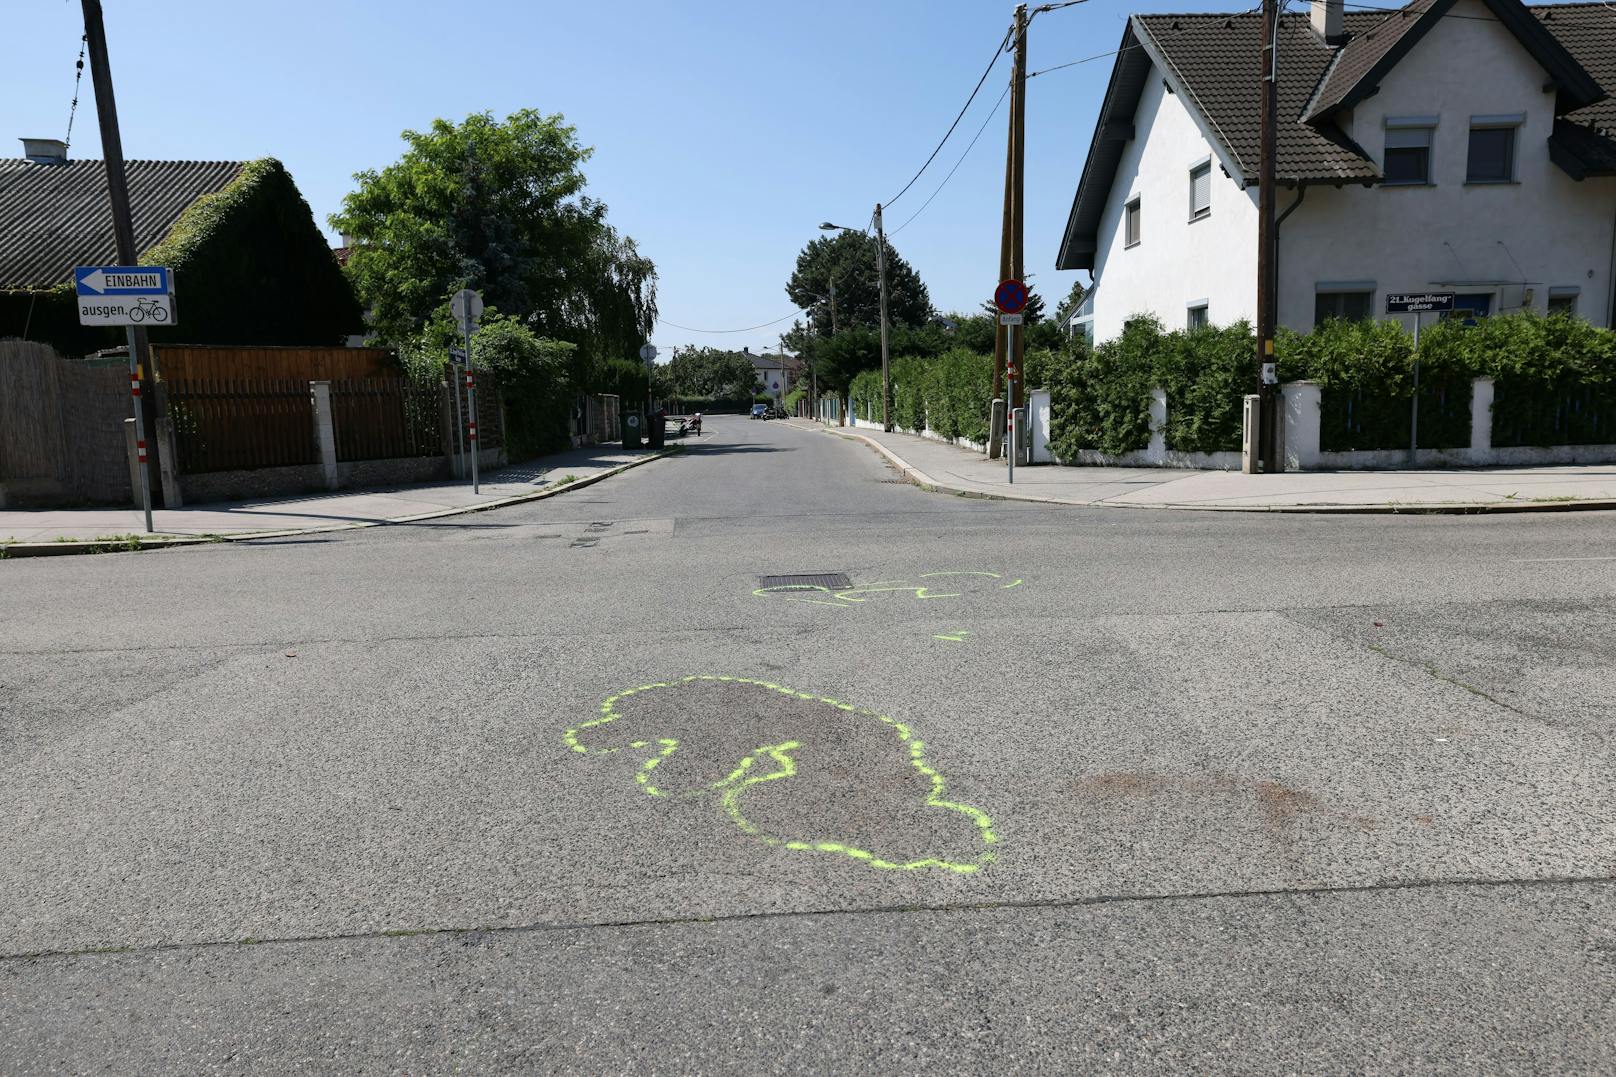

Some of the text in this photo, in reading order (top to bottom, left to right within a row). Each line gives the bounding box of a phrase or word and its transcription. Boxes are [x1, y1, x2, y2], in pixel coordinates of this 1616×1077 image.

[105, 275, 157, 287] EINBAHN
[82, 305, 128, 318] ausgen.
[1407, 303, 1433, 312] gasse
